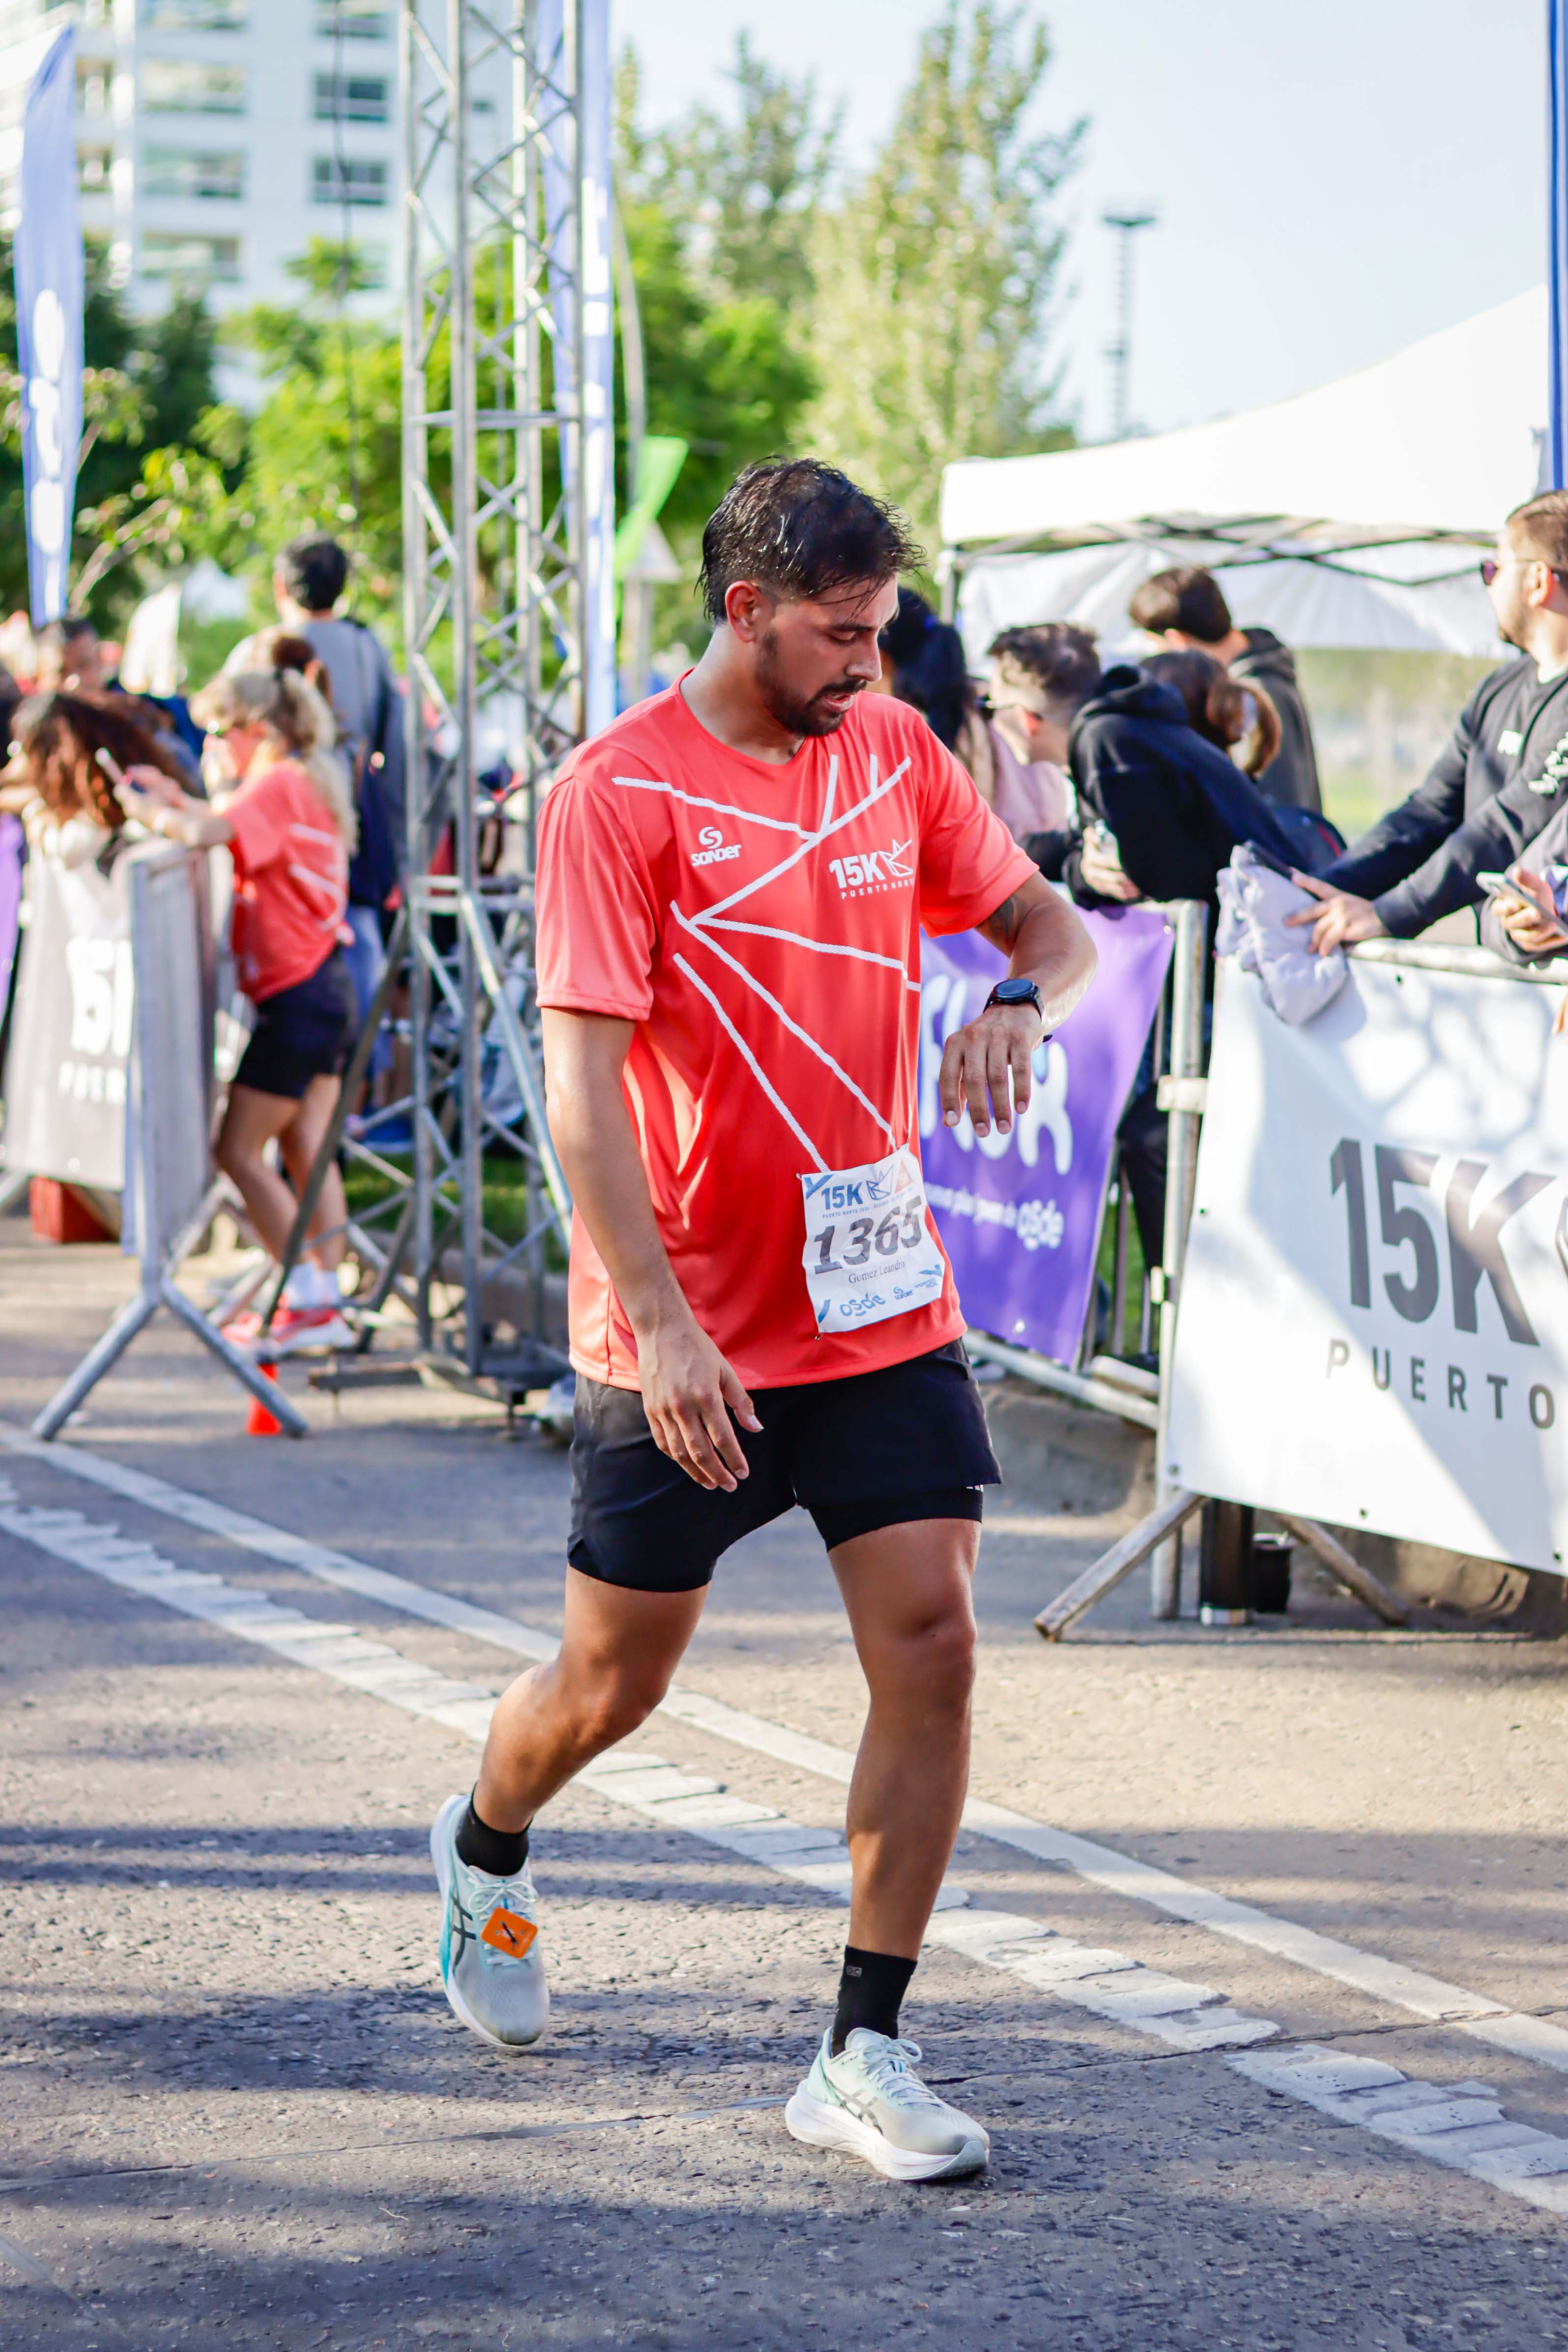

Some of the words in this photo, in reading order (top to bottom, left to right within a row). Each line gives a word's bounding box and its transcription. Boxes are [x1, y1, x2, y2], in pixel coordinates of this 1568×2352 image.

[829, 851, 886, 889] 15K
[821, 1181, 863, 1210] 15K
[814, 1195, 921, 1274] 1365
[1330, 1137, 1558, 1347] 15K
[849, 1270, 878, 1284] Gomez
[880, 1261, 905, 1276] Leandro
[1327, 1338, 1555, 1430] PUERTO
